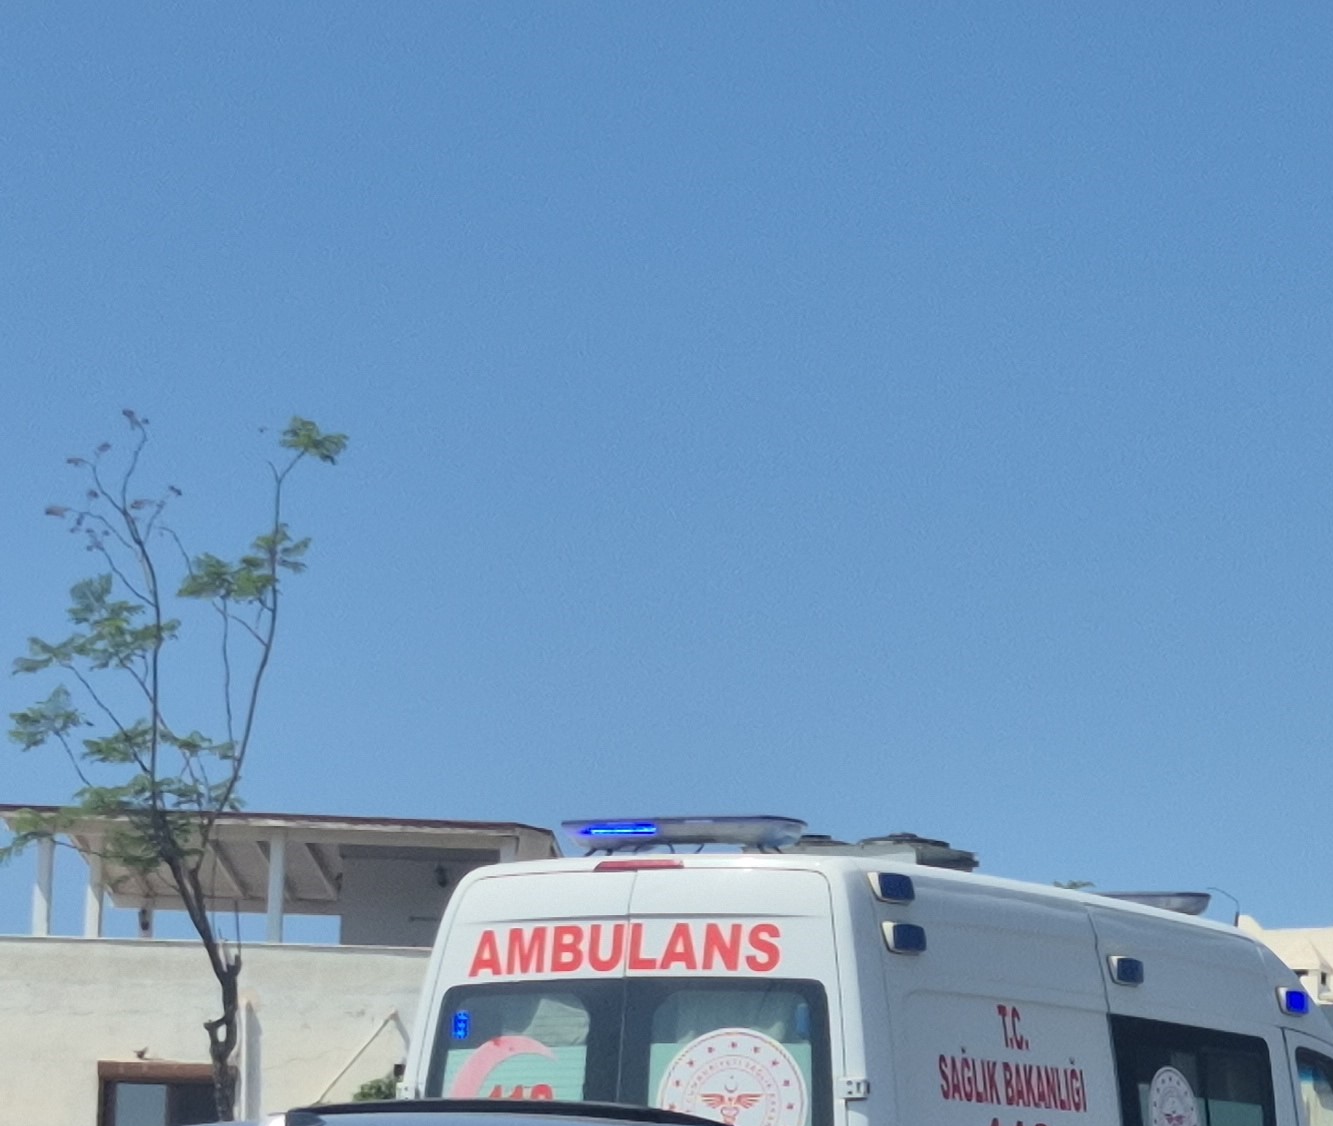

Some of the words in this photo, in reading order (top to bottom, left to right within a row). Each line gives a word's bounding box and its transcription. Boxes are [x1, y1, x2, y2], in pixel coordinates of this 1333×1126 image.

[469, 922, 780, 976] AMBULANS
[997, 1005, 1029, 1050] T.C.
[939, 1046, 1002, 1105] SAĞLIK
[1003, 1056, 1087, 1113] BAKANLIĞI
